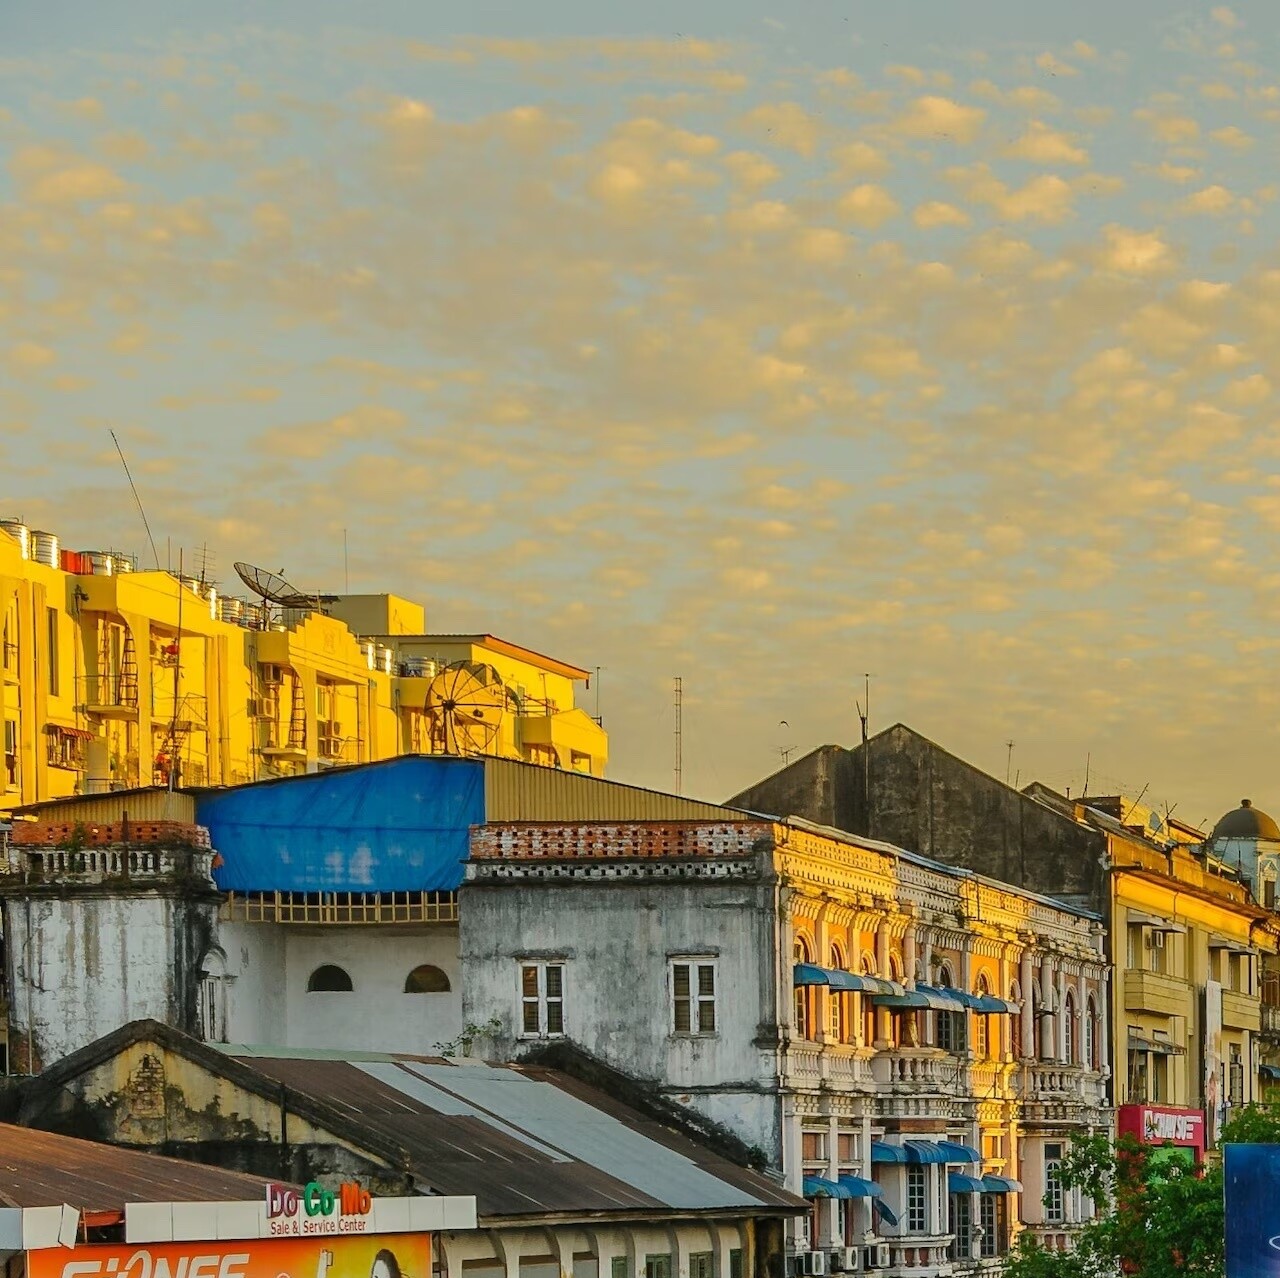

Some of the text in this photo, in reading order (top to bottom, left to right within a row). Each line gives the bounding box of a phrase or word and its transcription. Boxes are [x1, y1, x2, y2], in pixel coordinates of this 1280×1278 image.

[266, 1181, 372, 1218] Do Co Mo
[270, 1218, 366, 1235] Sale & Service Center
